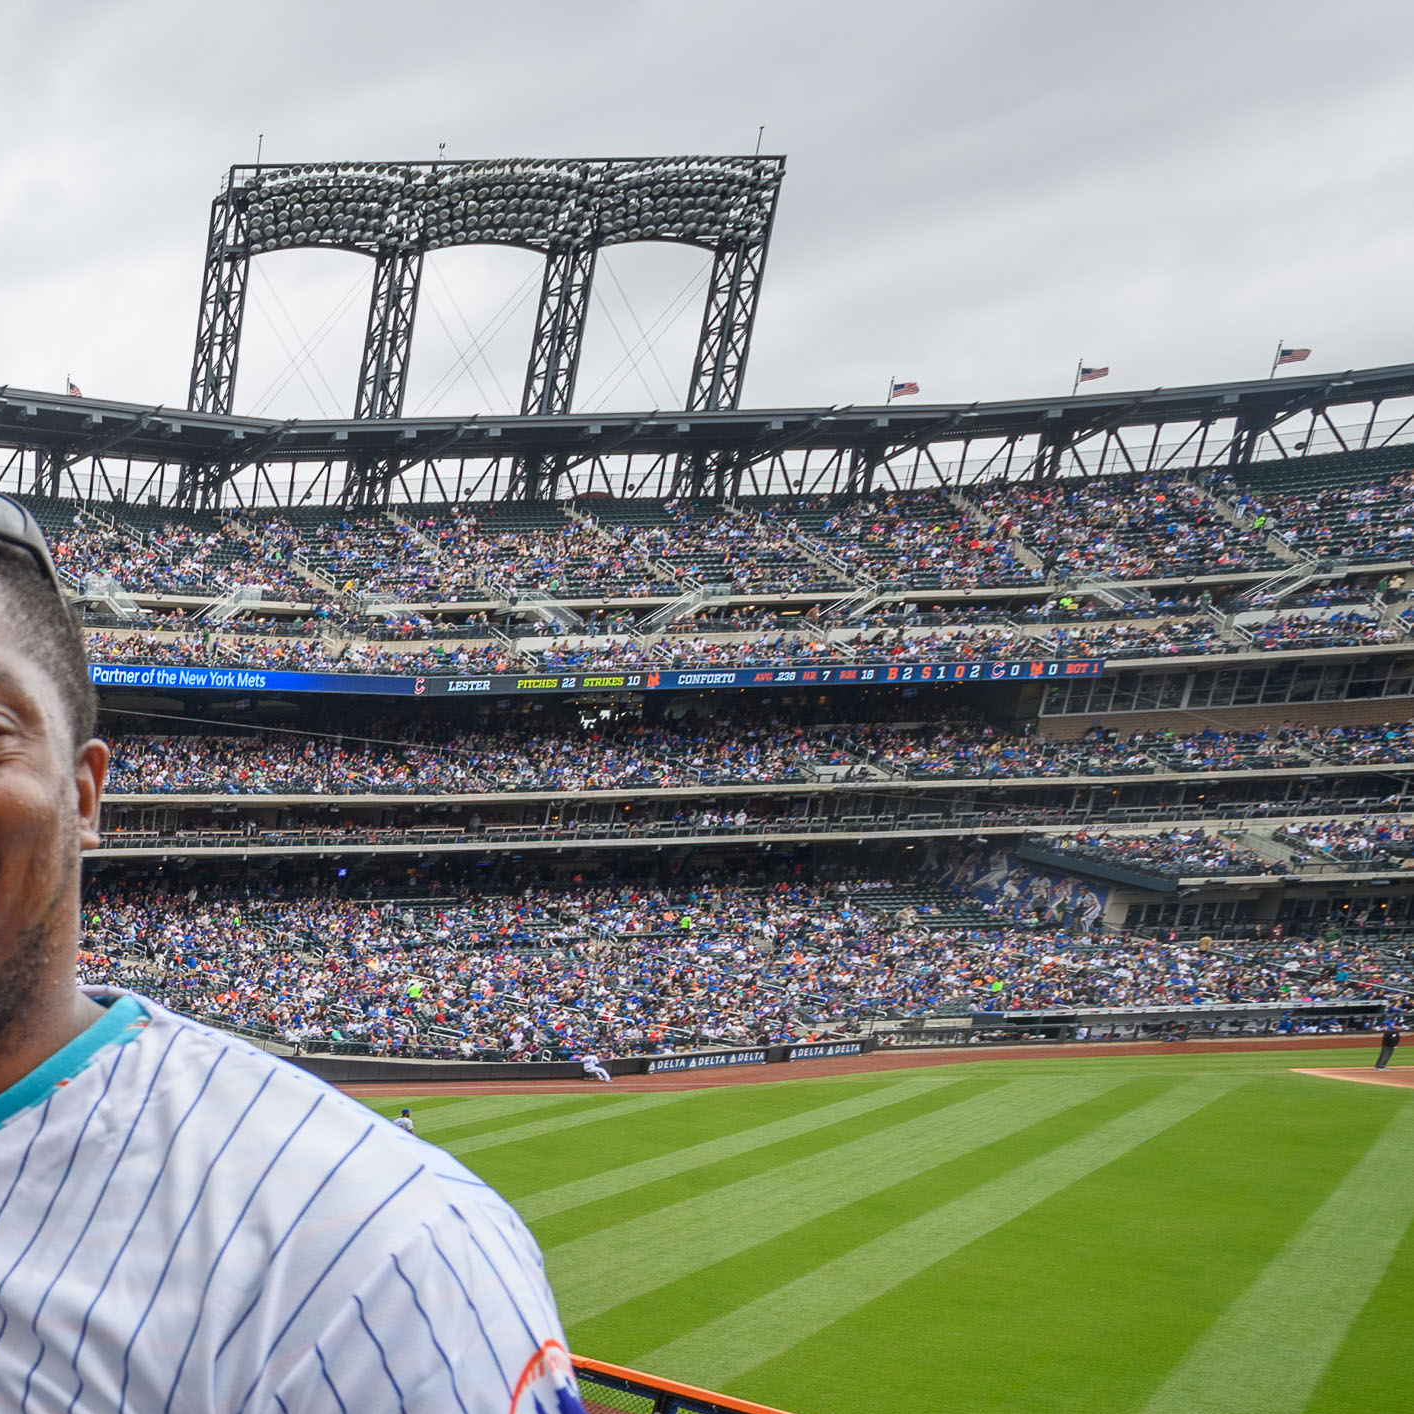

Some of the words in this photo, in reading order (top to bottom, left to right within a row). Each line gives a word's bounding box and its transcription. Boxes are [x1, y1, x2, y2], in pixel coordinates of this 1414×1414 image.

[92, 667, 139, 684] Partner
[141, 669, 155, 685] of
[156, 670, 177, 685] the
[179, 671, 207, 686] New
[209, 672, 235, 688] York
[237, 673, 266, 688] Mets
[447, 680, 491, 692] LESTER
[516, 679, 558, 689] PITCHES
[561, 677, 576, 689] 22
[583, 676, 624, 688] STRIKES
[626, 675, 641, 687] 10
[677, 673, 737, 685] CONFORTO
[822, 670, 831, 681] 7
[902, 667, 913, 681] 2
[936, 666, 946, 680] 1
[969, 664, 981, 678] 2
[797, 1046, 824, 1057] DELTA
[834, 1043, 861, 1054] DELTA
[657, 1058, 686, 1070] DELTA
[698, 1056, 726, 1067] DELTA
[737, 1051, 765, 1063] DELTA
